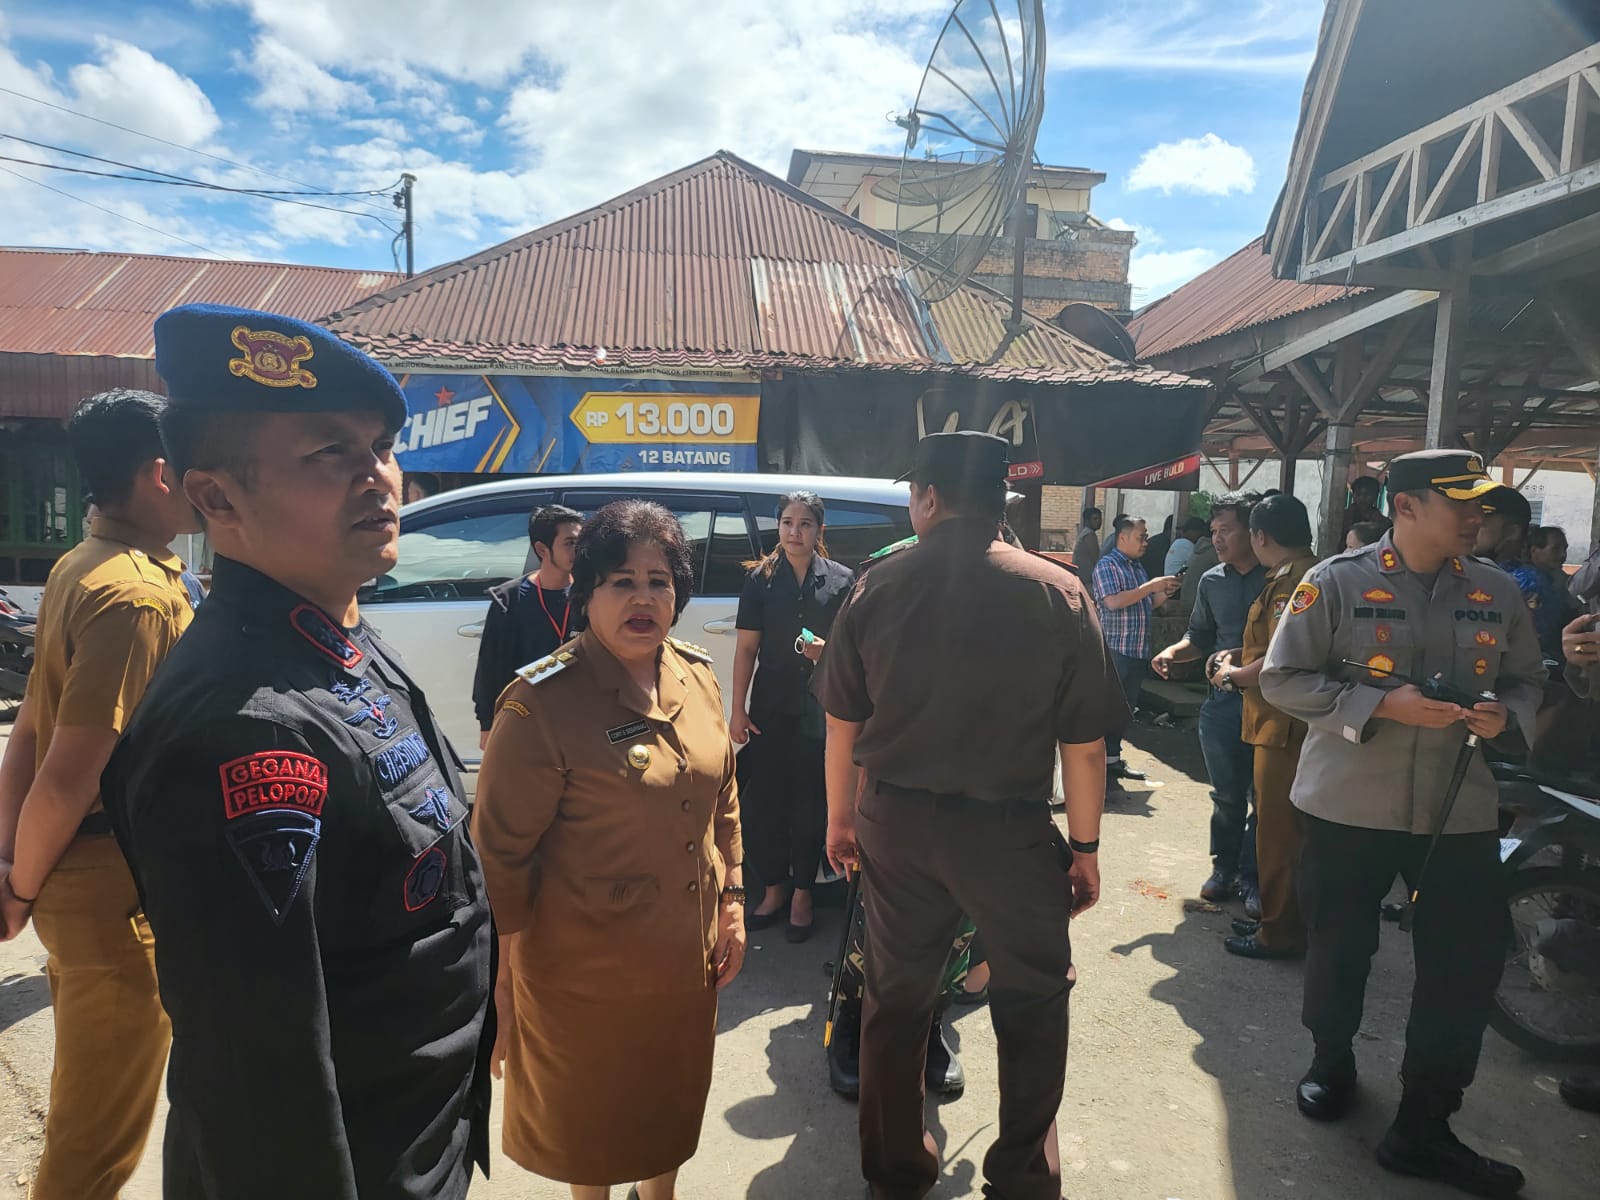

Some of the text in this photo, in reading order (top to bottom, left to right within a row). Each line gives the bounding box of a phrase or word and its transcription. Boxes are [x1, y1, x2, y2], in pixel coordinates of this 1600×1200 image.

[392, 395, 493, 454] CHIEF
[585, 402, 735, 436] RP 13.000
[638, 450, 731, 466] 12 BATANG
[1144, 470, 1162, 486] LIVE
[1454, 609, 1502, 625] POLRI
[230, 757, 321, 784] GEGANA
[233, 783, 321, 811] PELOPOR
